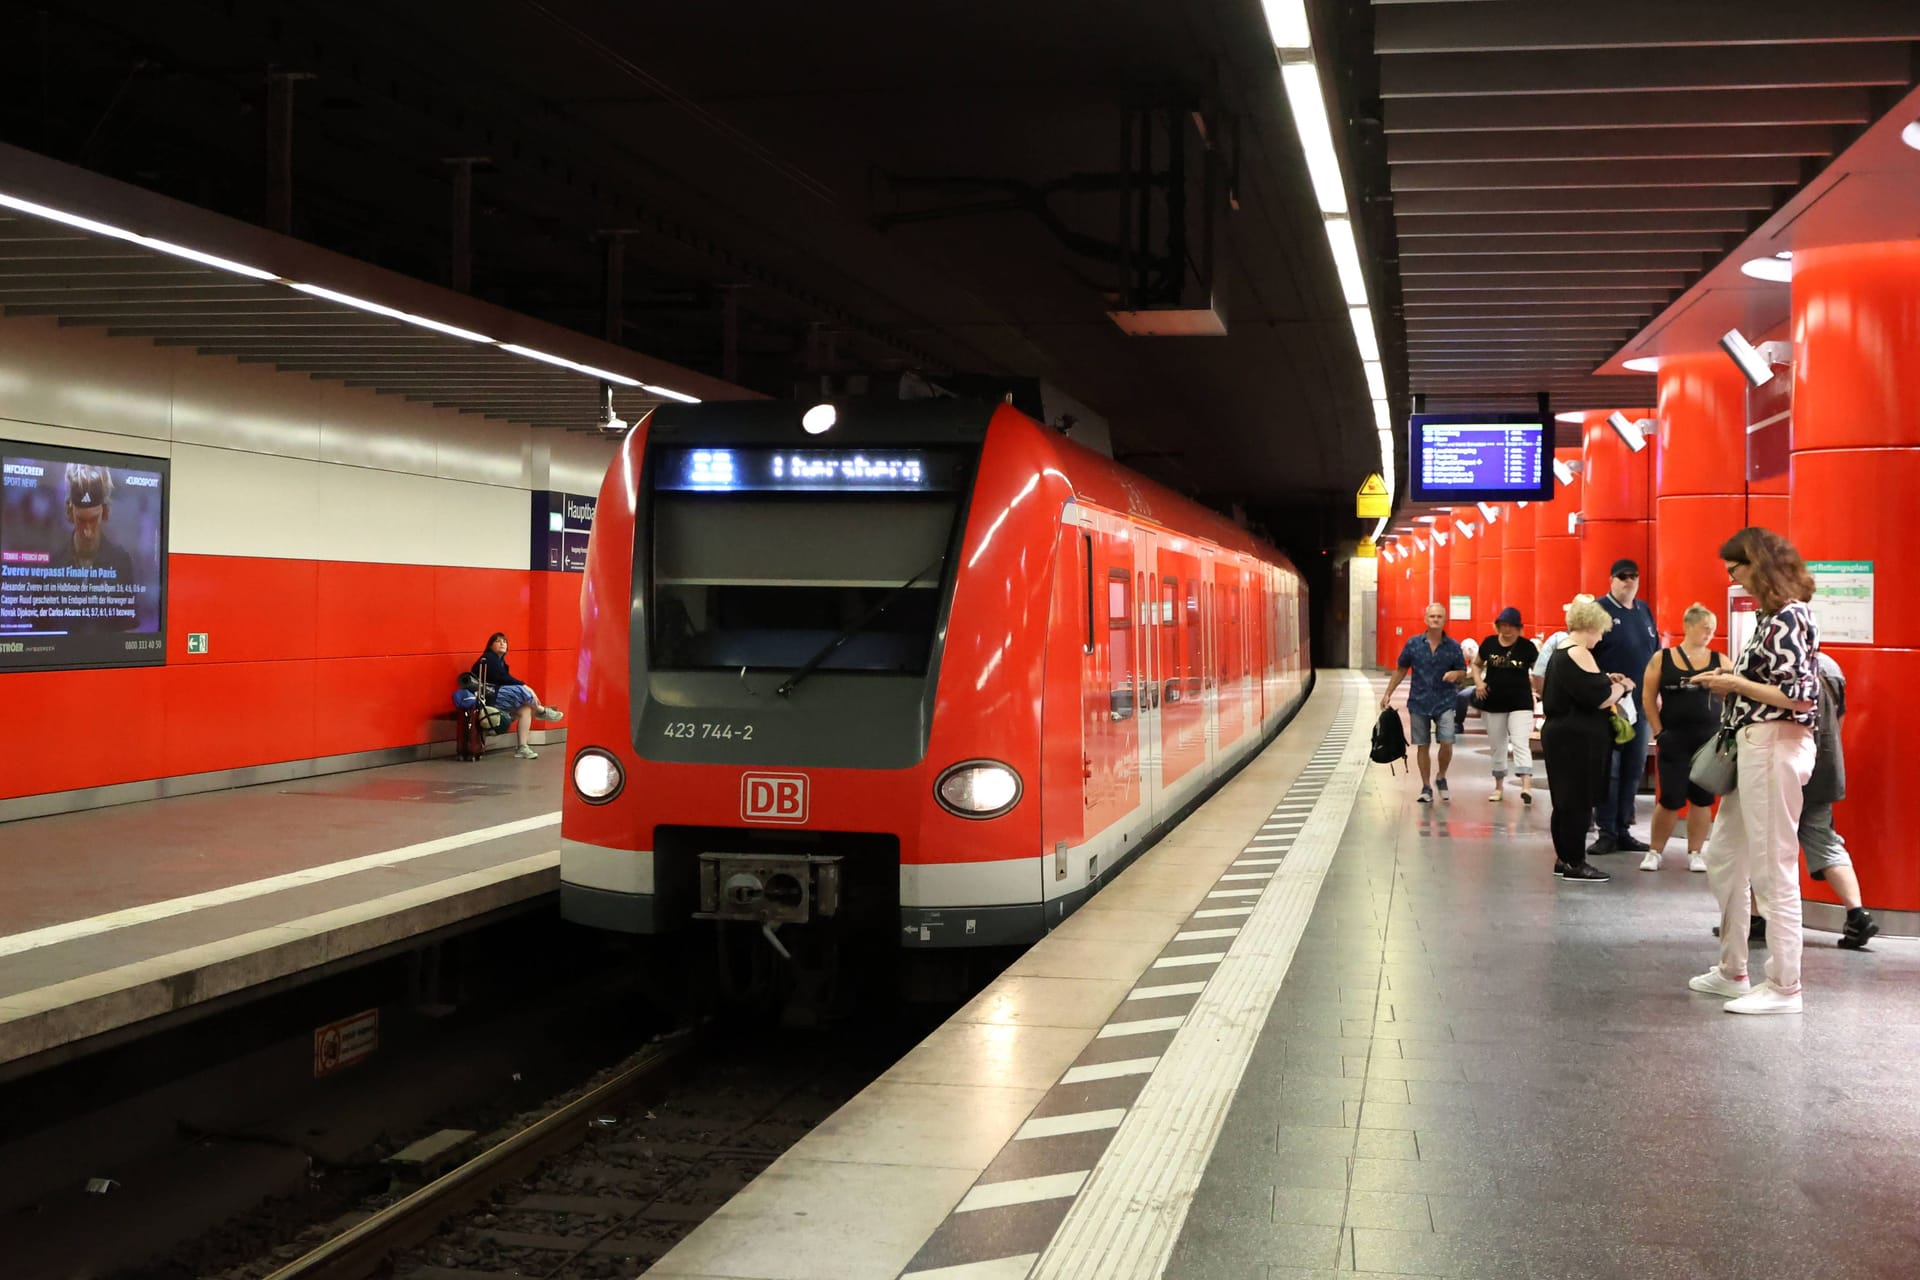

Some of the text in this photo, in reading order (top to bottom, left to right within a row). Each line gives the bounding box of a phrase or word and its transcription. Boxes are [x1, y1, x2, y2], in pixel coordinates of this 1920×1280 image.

[4, 464, 44, 476] INFOSCREEN
[2, 565, 117, 579] Zverev verpasst Finale in Paris
[1, 583, 26, 591] Alexander
[27, 583, 42, 591] Zverev
[1, 608, 16, 616] Novak
[48, 608, 63, 616] Carlos
[64, 608, 81, 616] Alcaraz
[664, 723, 753, 740] 423 744-2
[750, 781, 800, 814] DB
